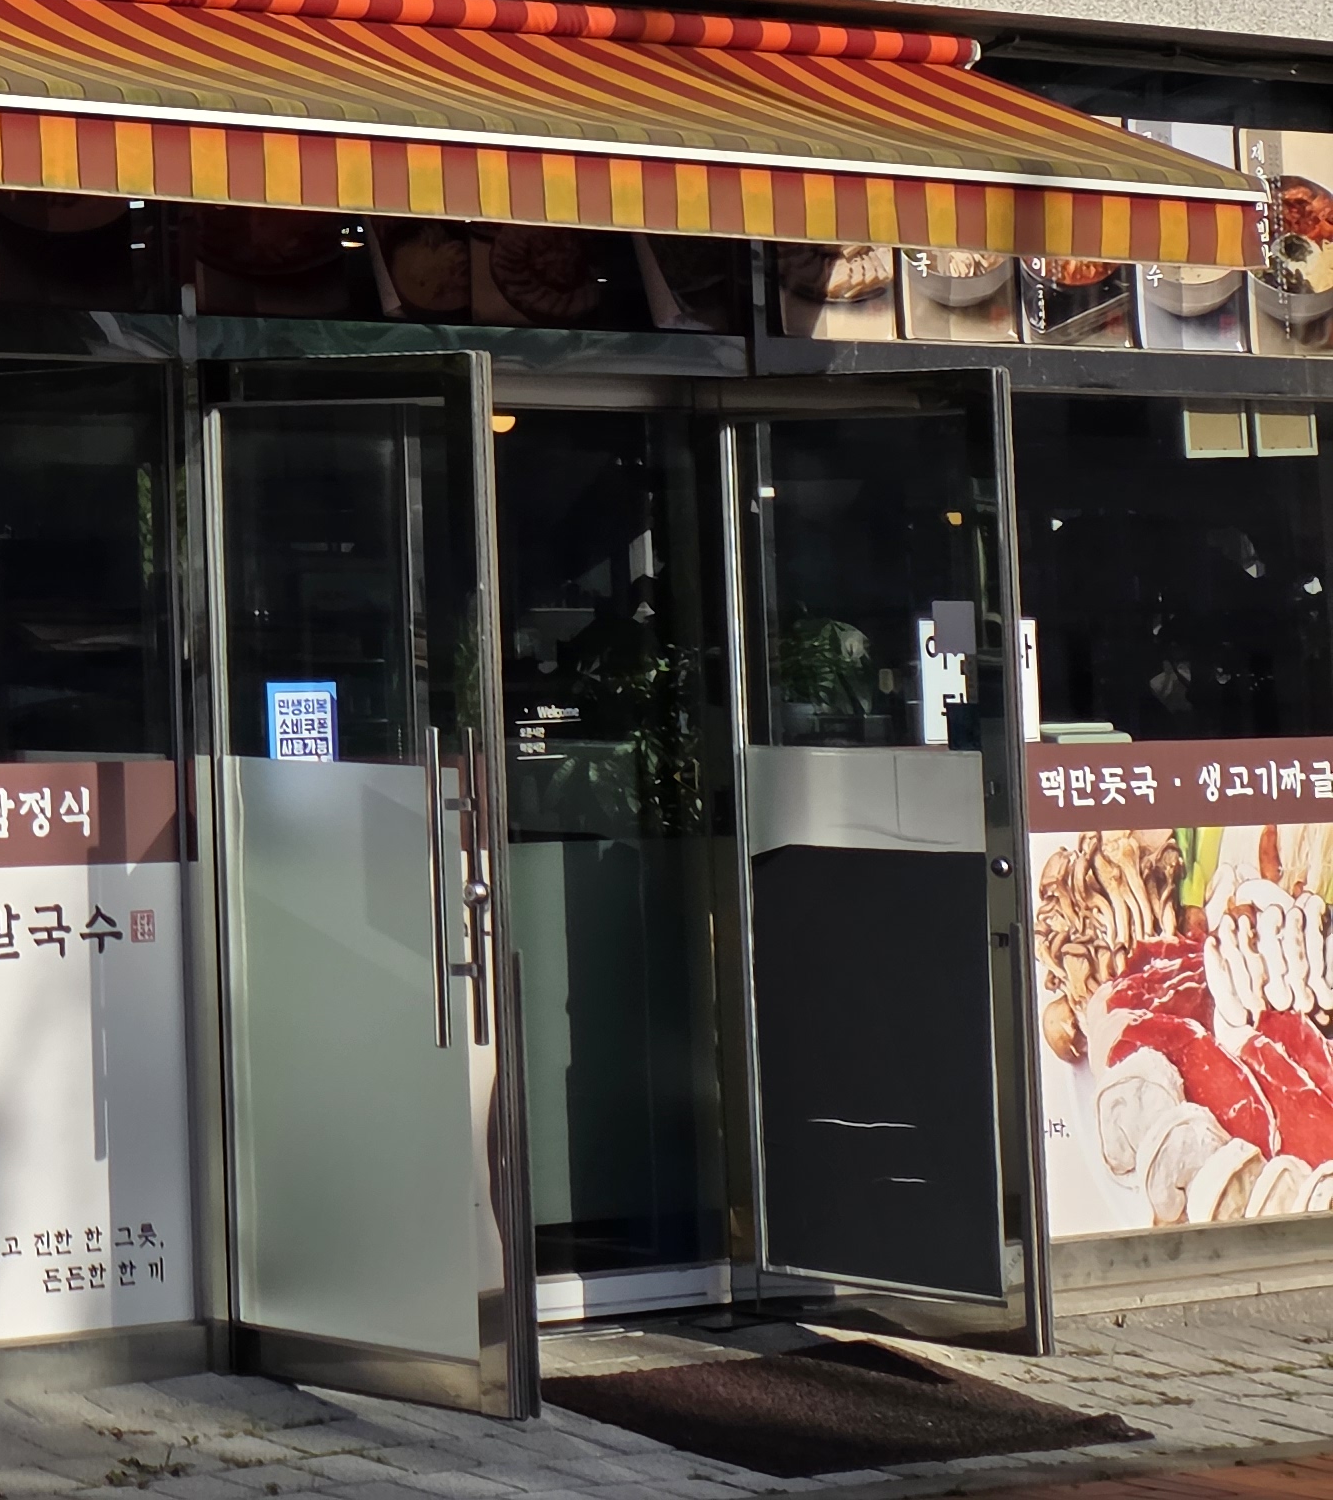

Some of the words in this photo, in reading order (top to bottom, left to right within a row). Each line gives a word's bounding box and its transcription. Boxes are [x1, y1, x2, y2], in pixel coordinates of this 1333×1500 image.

[278, 698, 328, 716] 민생회복
[279, 718, 328, 735] 소비쿠폰
[281, 738, 328, 756] 사용가능
[34, 1228, 73, 1257] 진한
[84, 1225, 103, 1253] 한
[42, 1262, 107, 1293] 든든한
[118, 1259, 137, 1286] 한
[148, 1256, 165, 1283] 끼
